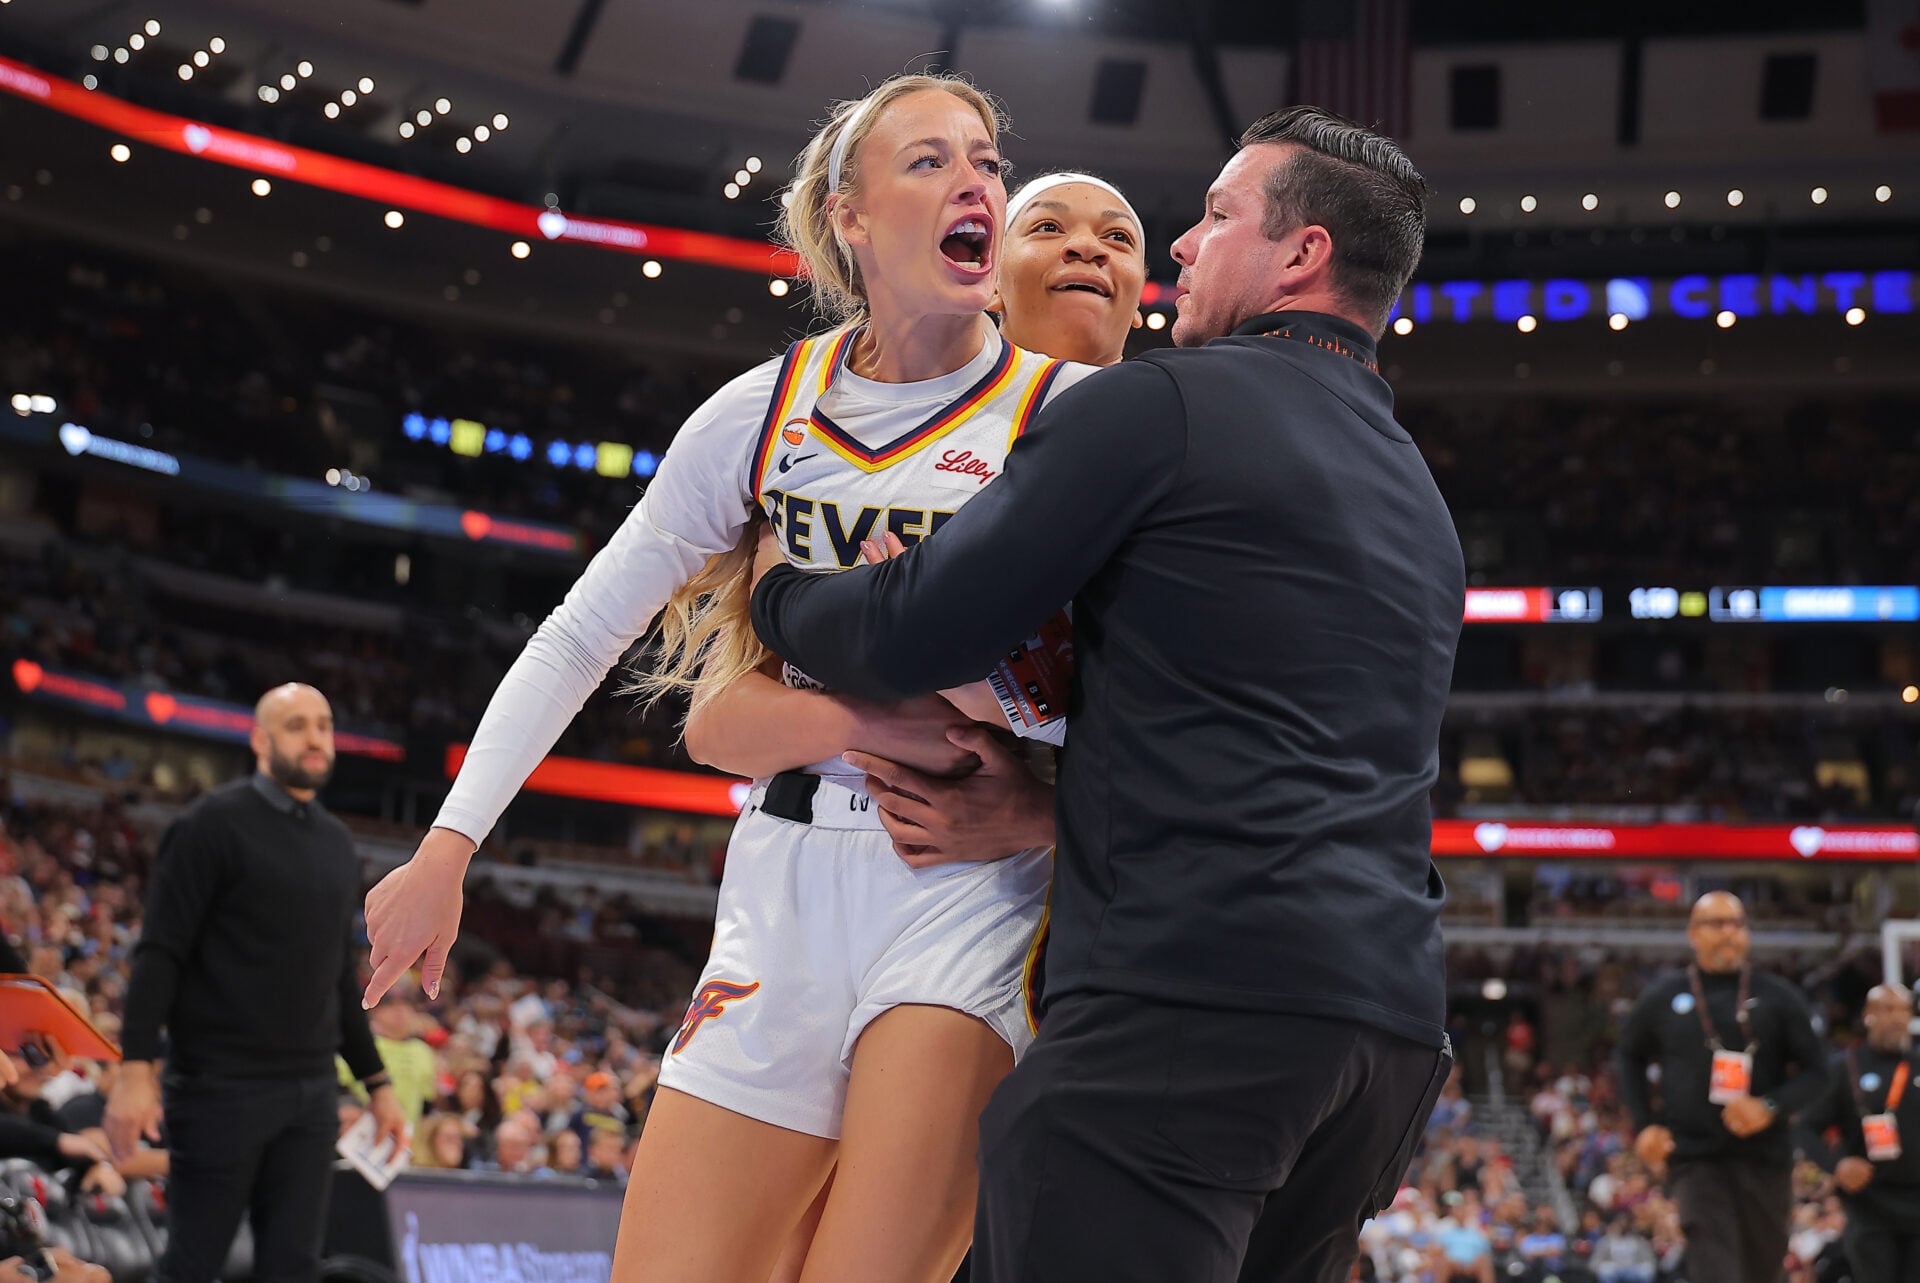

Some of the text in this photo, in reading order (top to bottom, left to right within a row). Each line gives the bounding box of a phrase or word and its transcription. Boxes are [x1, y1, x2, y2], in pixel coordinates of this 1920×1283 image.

[1388, 278, 1592, 324] ITED
[935, 450, 996, 484] Lilly
[762, 487, 957, 569] FEVE
[1003, 667, 1032, 714] SECURITY
